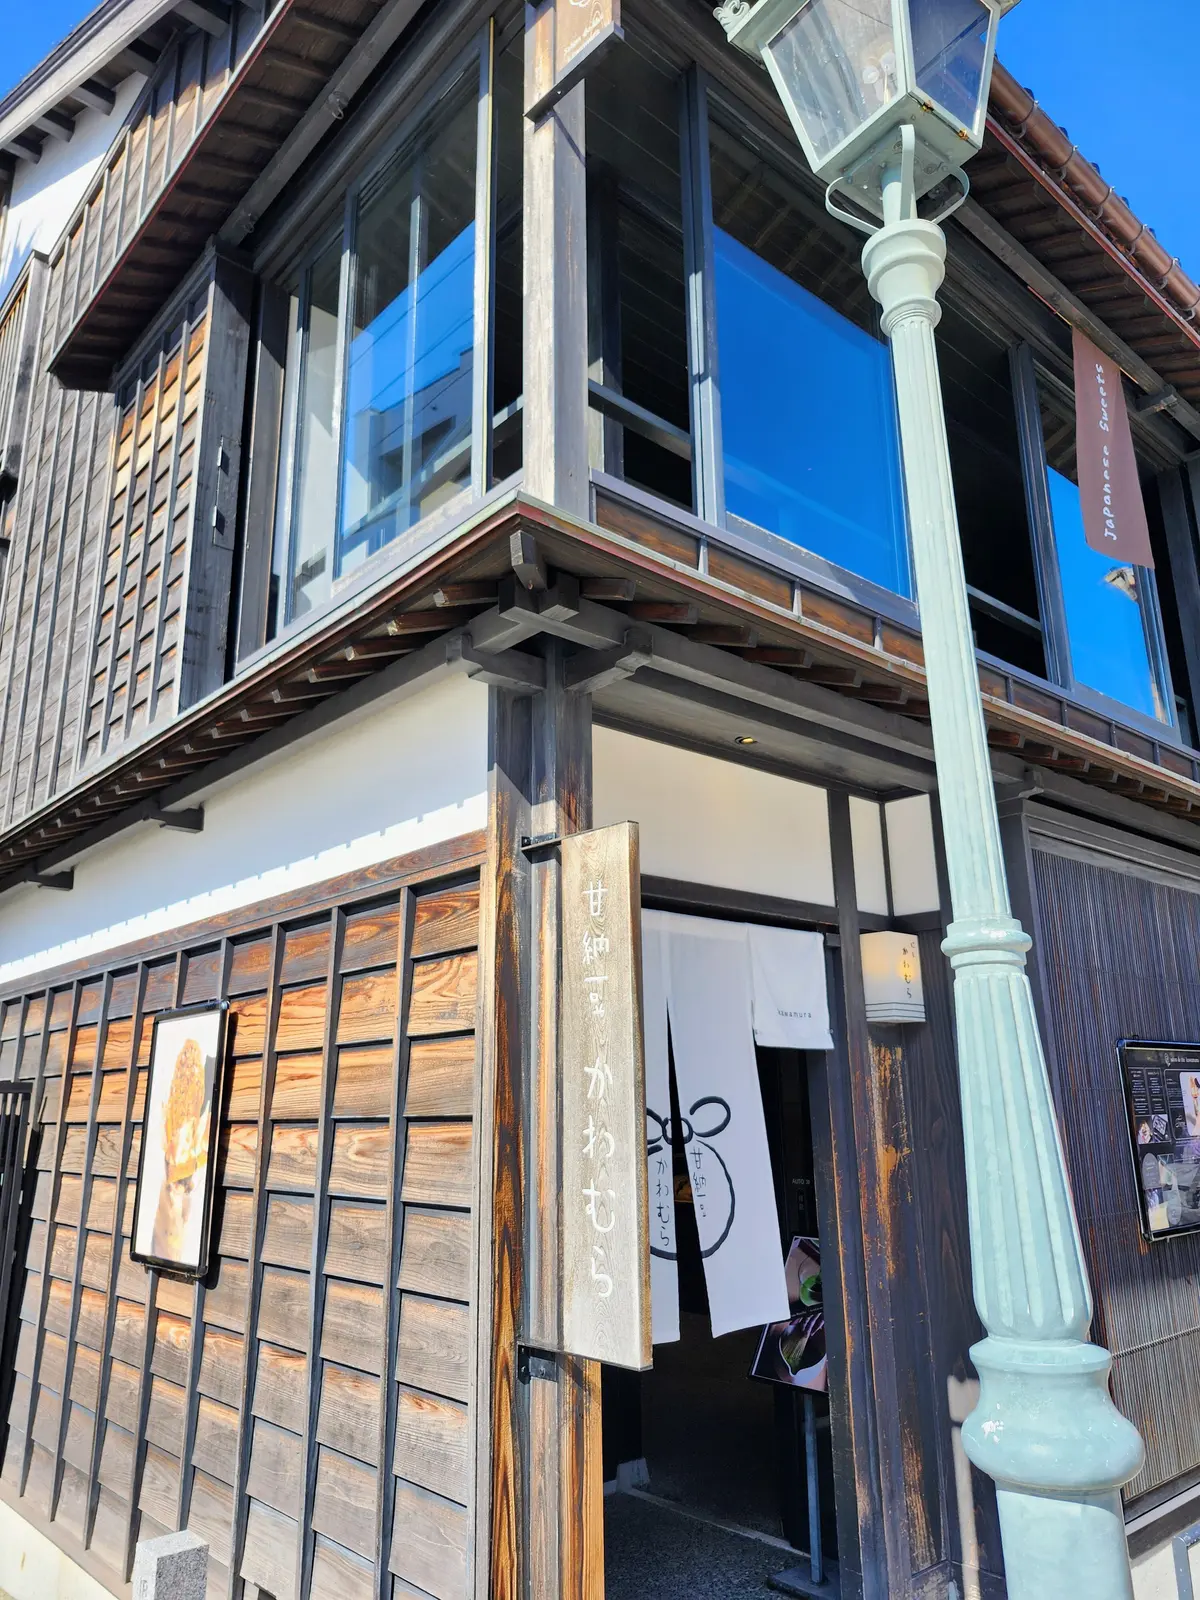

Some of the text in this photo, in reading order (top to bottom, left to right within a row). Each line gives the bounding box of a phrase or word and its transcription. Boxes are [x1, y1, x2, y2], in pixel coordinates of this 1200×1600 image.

[1095, 363, 1118, 541] Japanese Sweets
[656, 1158, 670, 1246] かわむら
